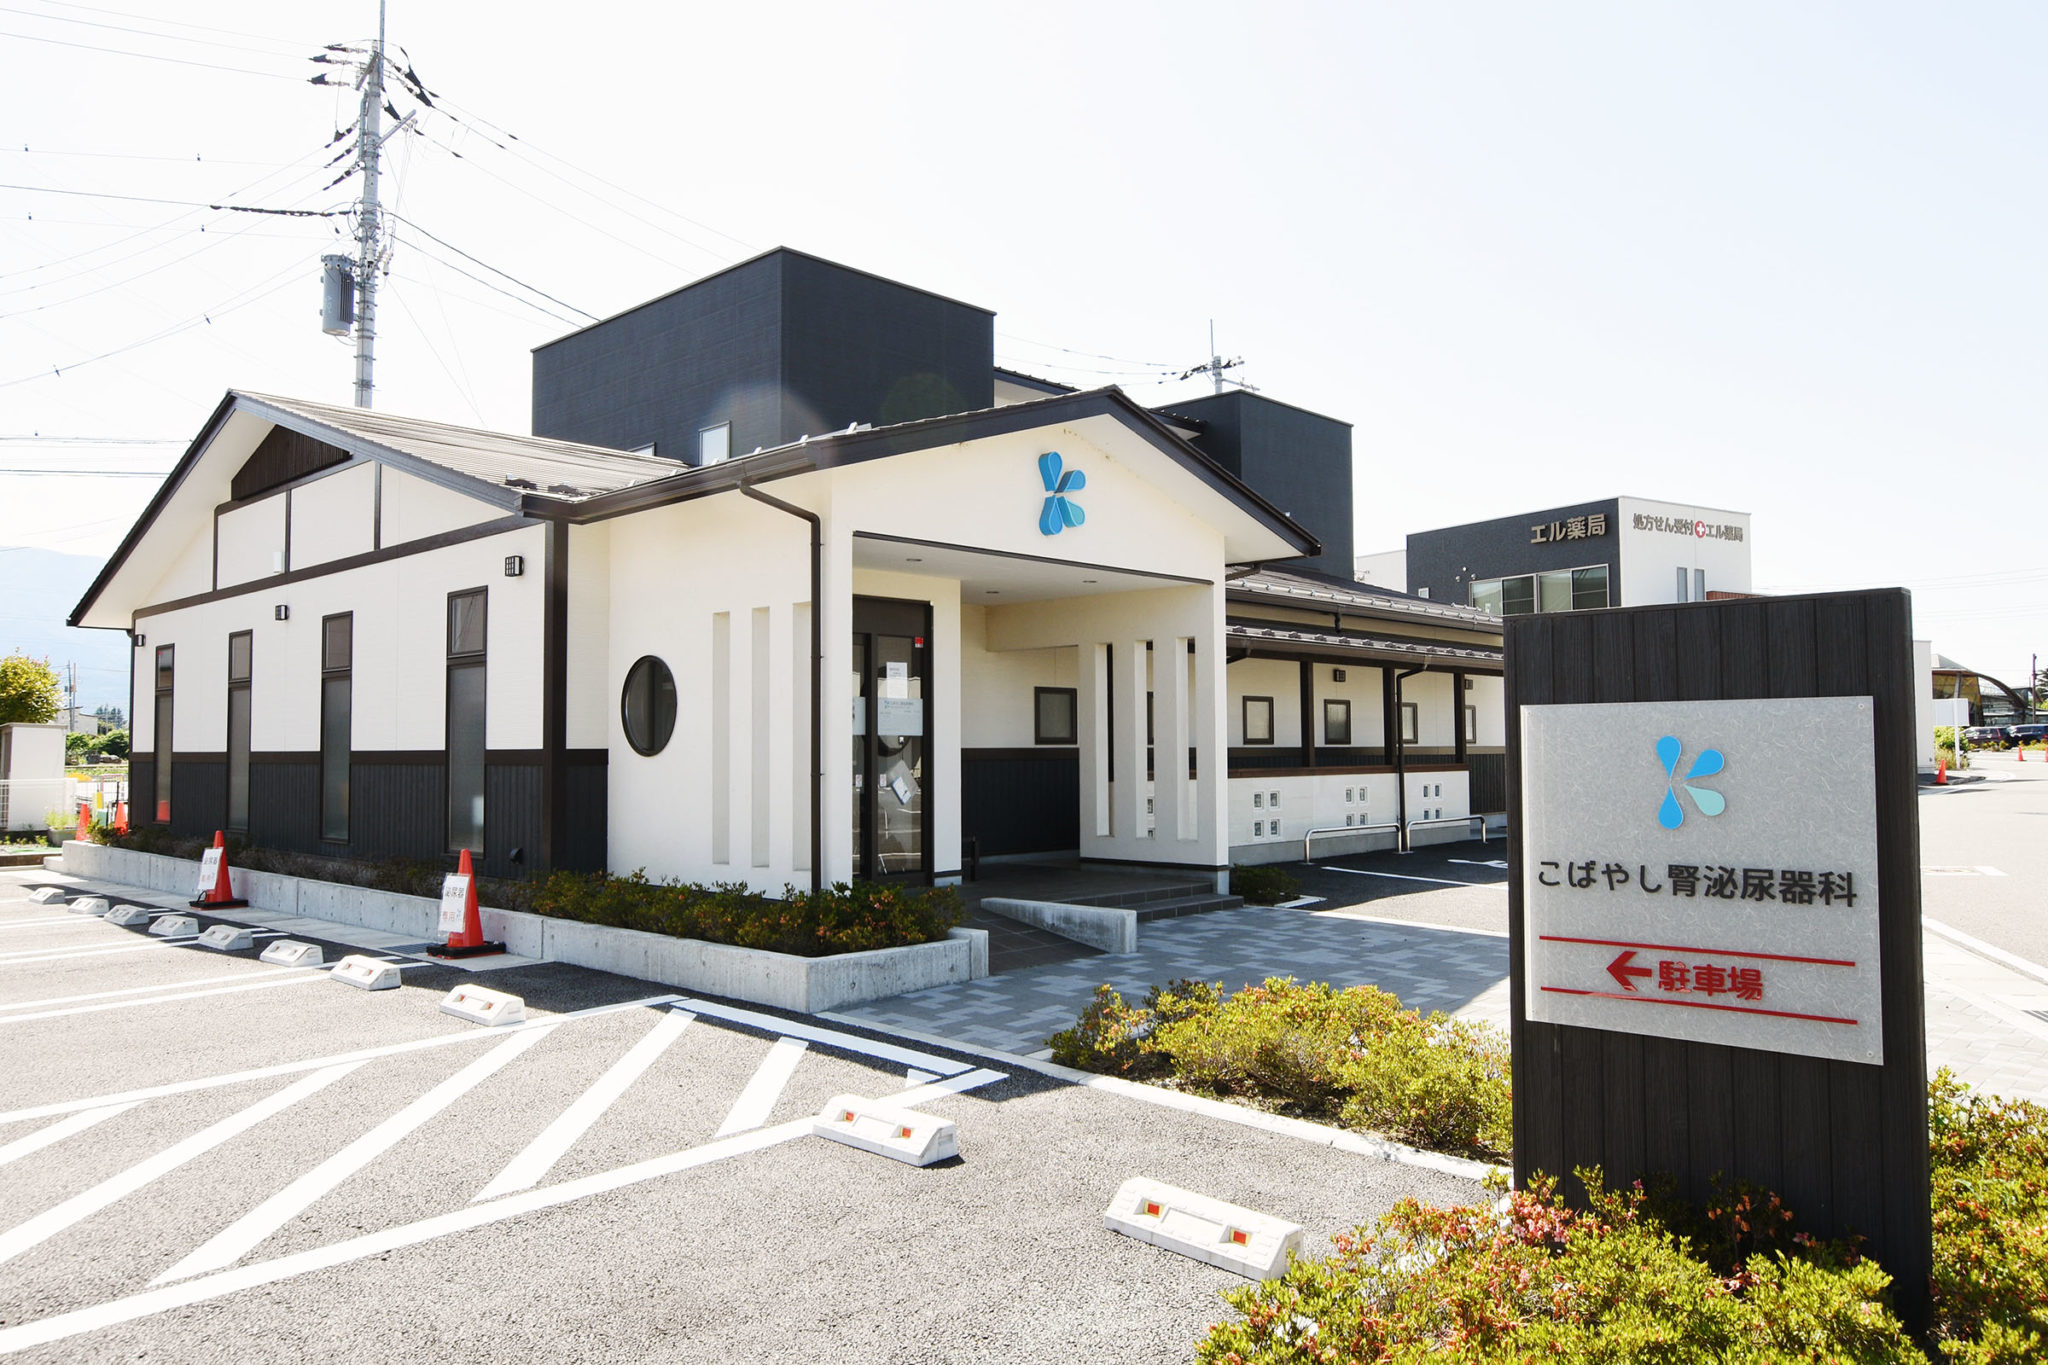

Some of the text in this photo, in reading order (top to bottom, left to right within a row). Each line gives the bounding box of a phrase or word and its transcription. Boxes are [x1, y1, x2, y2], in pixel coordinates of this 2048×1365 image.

[1530, 513, 1606, 544] エル薬局
[1632, 512, 1743, 542] 処方せん受付 エル薬局
[1538, 859, 1857, 908] こばやし腎泌尿器科
[1658, 960, 1763, 1001] 駐車場
